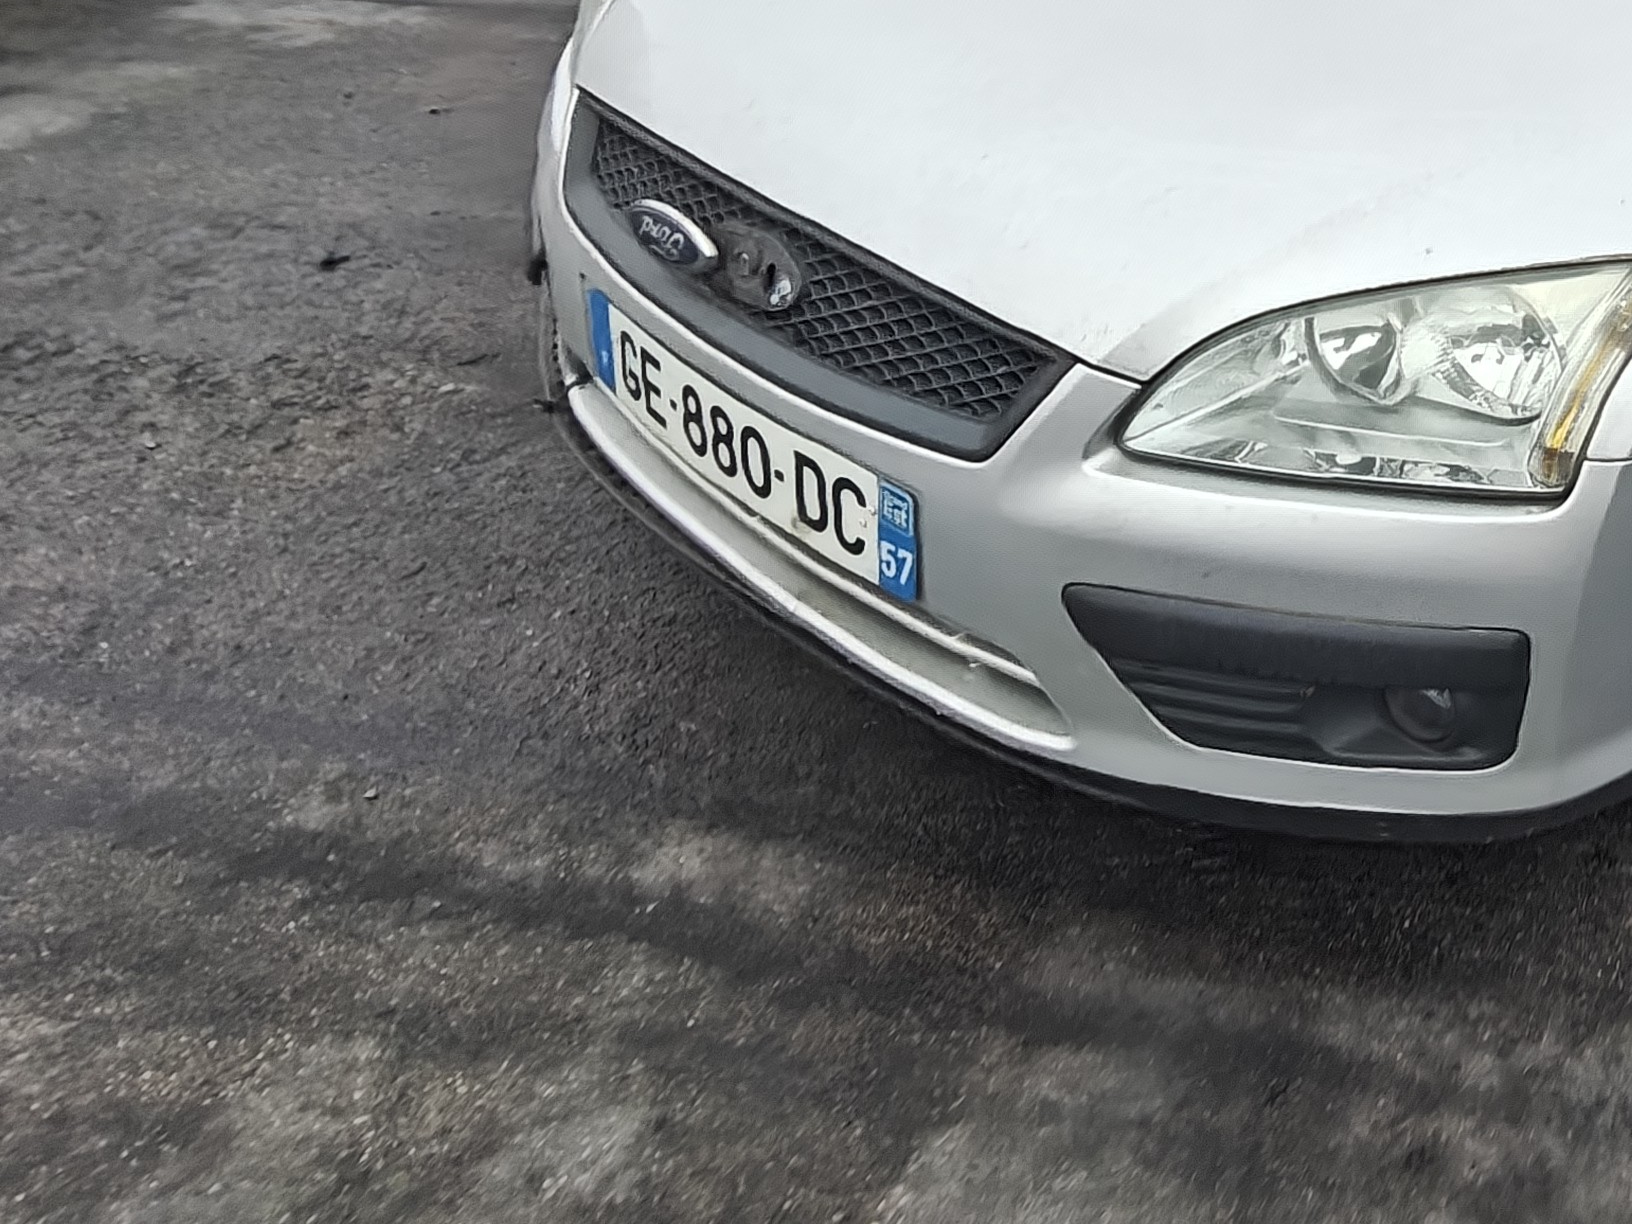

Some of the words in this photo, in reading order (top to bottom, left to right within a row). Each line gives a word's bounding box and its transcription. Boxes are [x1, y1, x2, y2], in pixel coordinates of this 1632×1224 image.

[638, 215, 685, 262] Ford
[620, 330, 867, 556] GE-880-DC
[880, 540, 913, 586] 57
